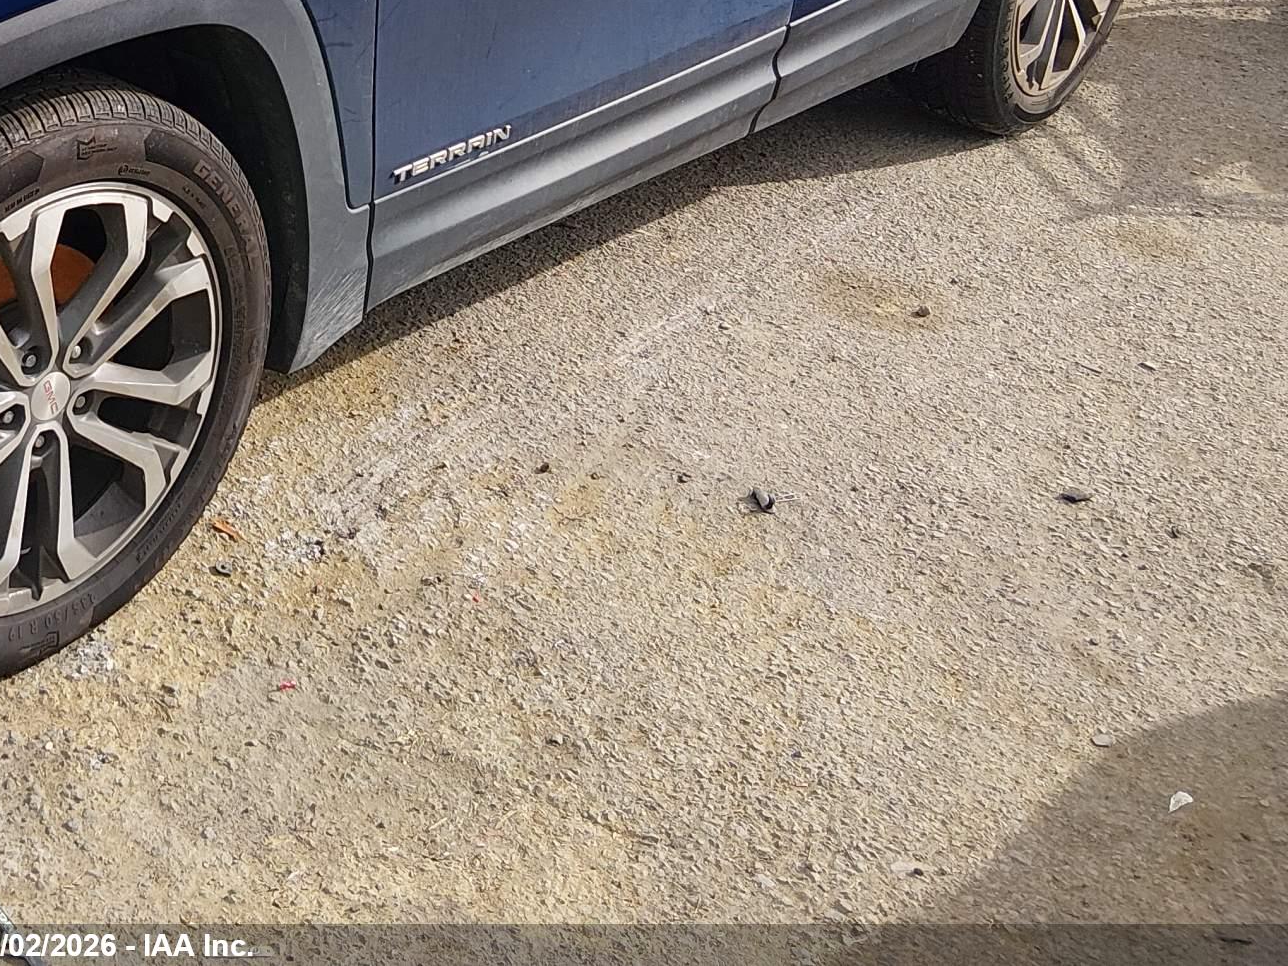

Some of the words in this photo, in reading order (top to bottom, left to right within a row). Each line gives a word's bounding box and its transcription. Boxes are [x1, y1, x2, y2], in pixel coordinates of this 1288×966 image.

[393, 124, 512, 183] TERRAIN
[194, 159, 260, 268] GENERAL
[43, 380, 58, 414] GMC
